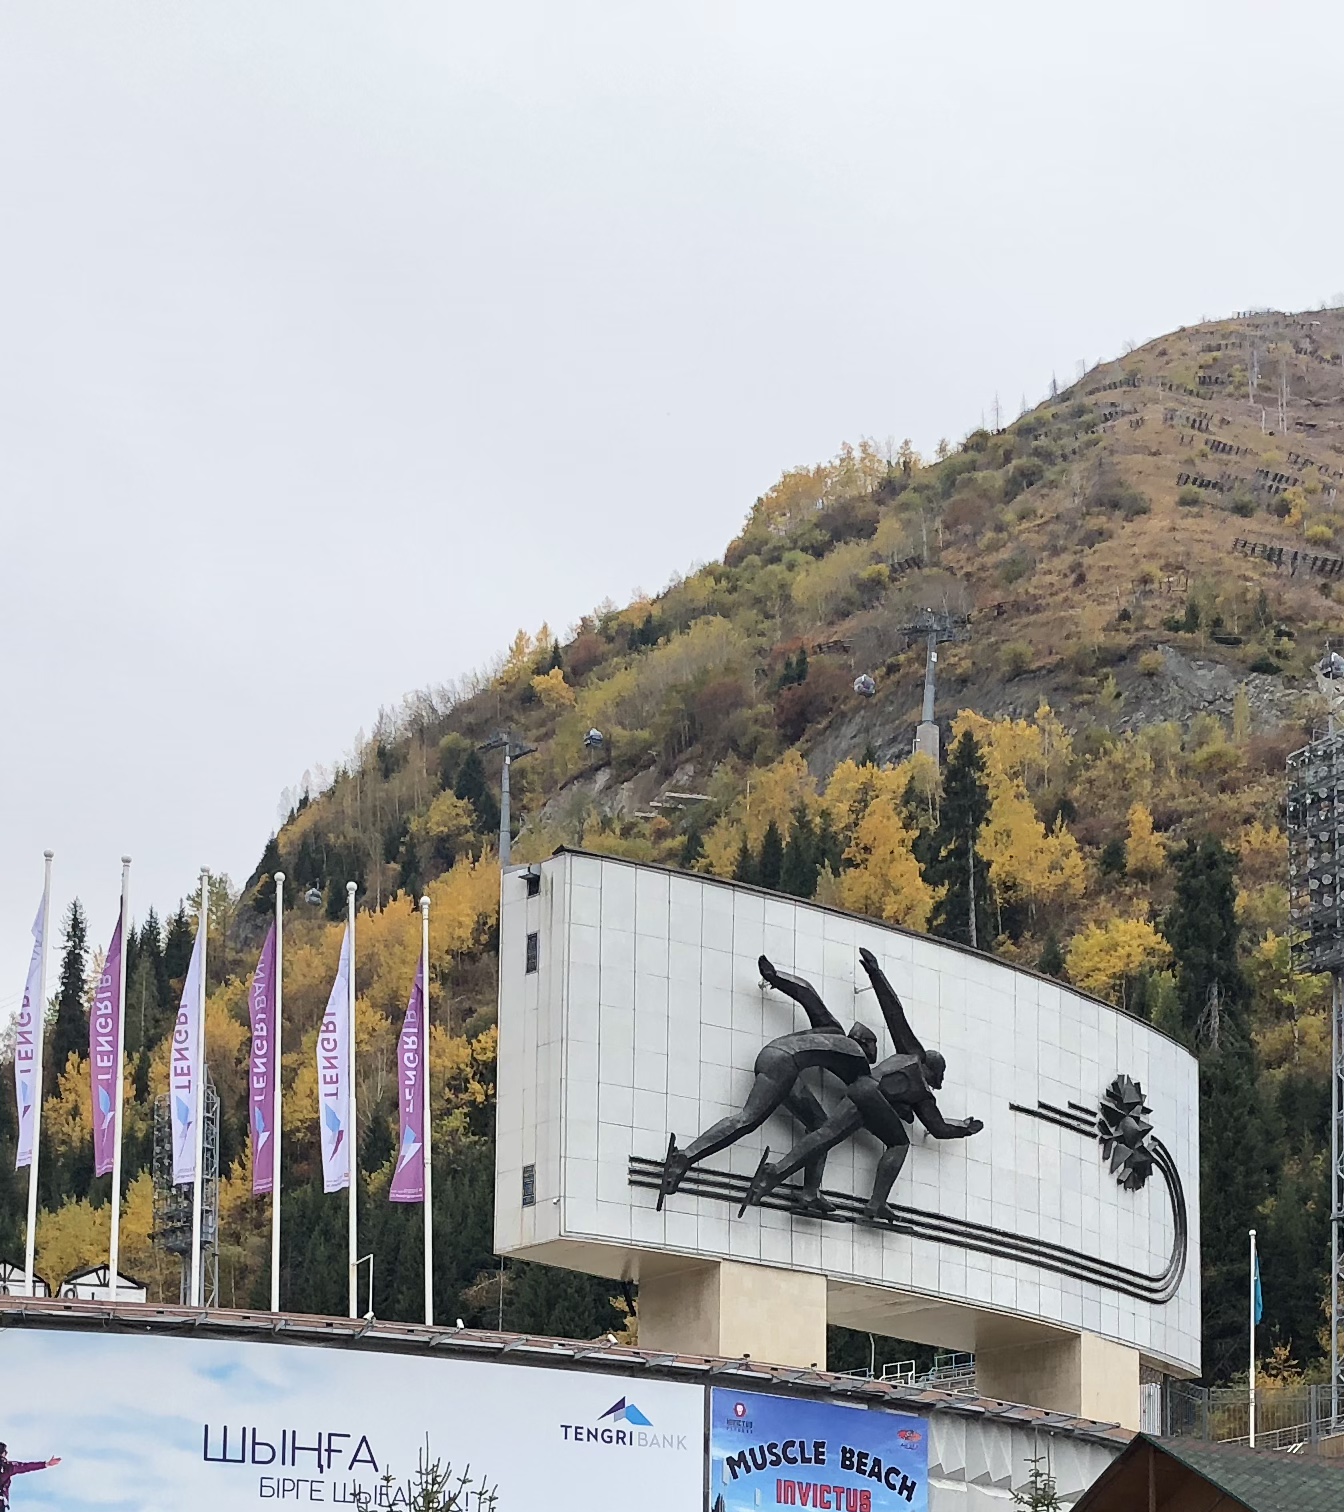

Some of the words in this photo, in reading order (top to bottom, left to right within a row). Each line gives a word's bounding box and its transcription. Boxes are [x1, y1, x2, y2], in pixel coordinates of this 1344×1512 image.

[203, 1424, 379, 1474] ШЫҢҒА
[725, 1440, 826, 1480] MUSCLE
[840, 1445, 917, 1502] BEACH
[259, 1477, 324, 1502] БІРГЕ
